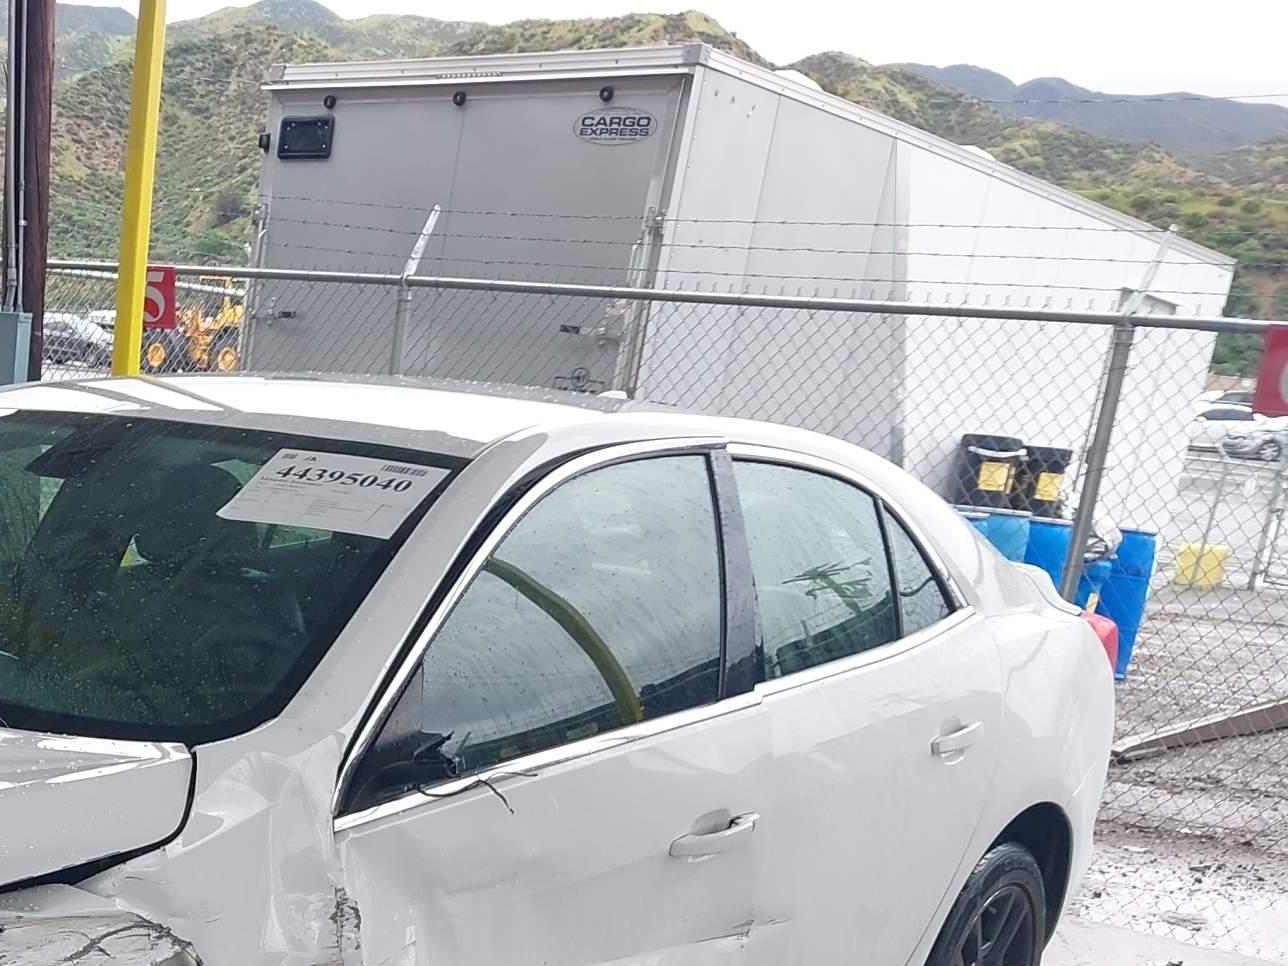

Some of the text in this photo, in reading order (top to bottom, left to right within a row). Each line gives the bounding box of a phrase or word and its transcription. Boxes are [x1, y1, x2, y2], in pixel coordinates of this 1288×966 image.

[581, 116, 652, 127] CARGO
[579, 127, 650, 136] EXPRESS
[276, 465, 414, 492] 44395040
